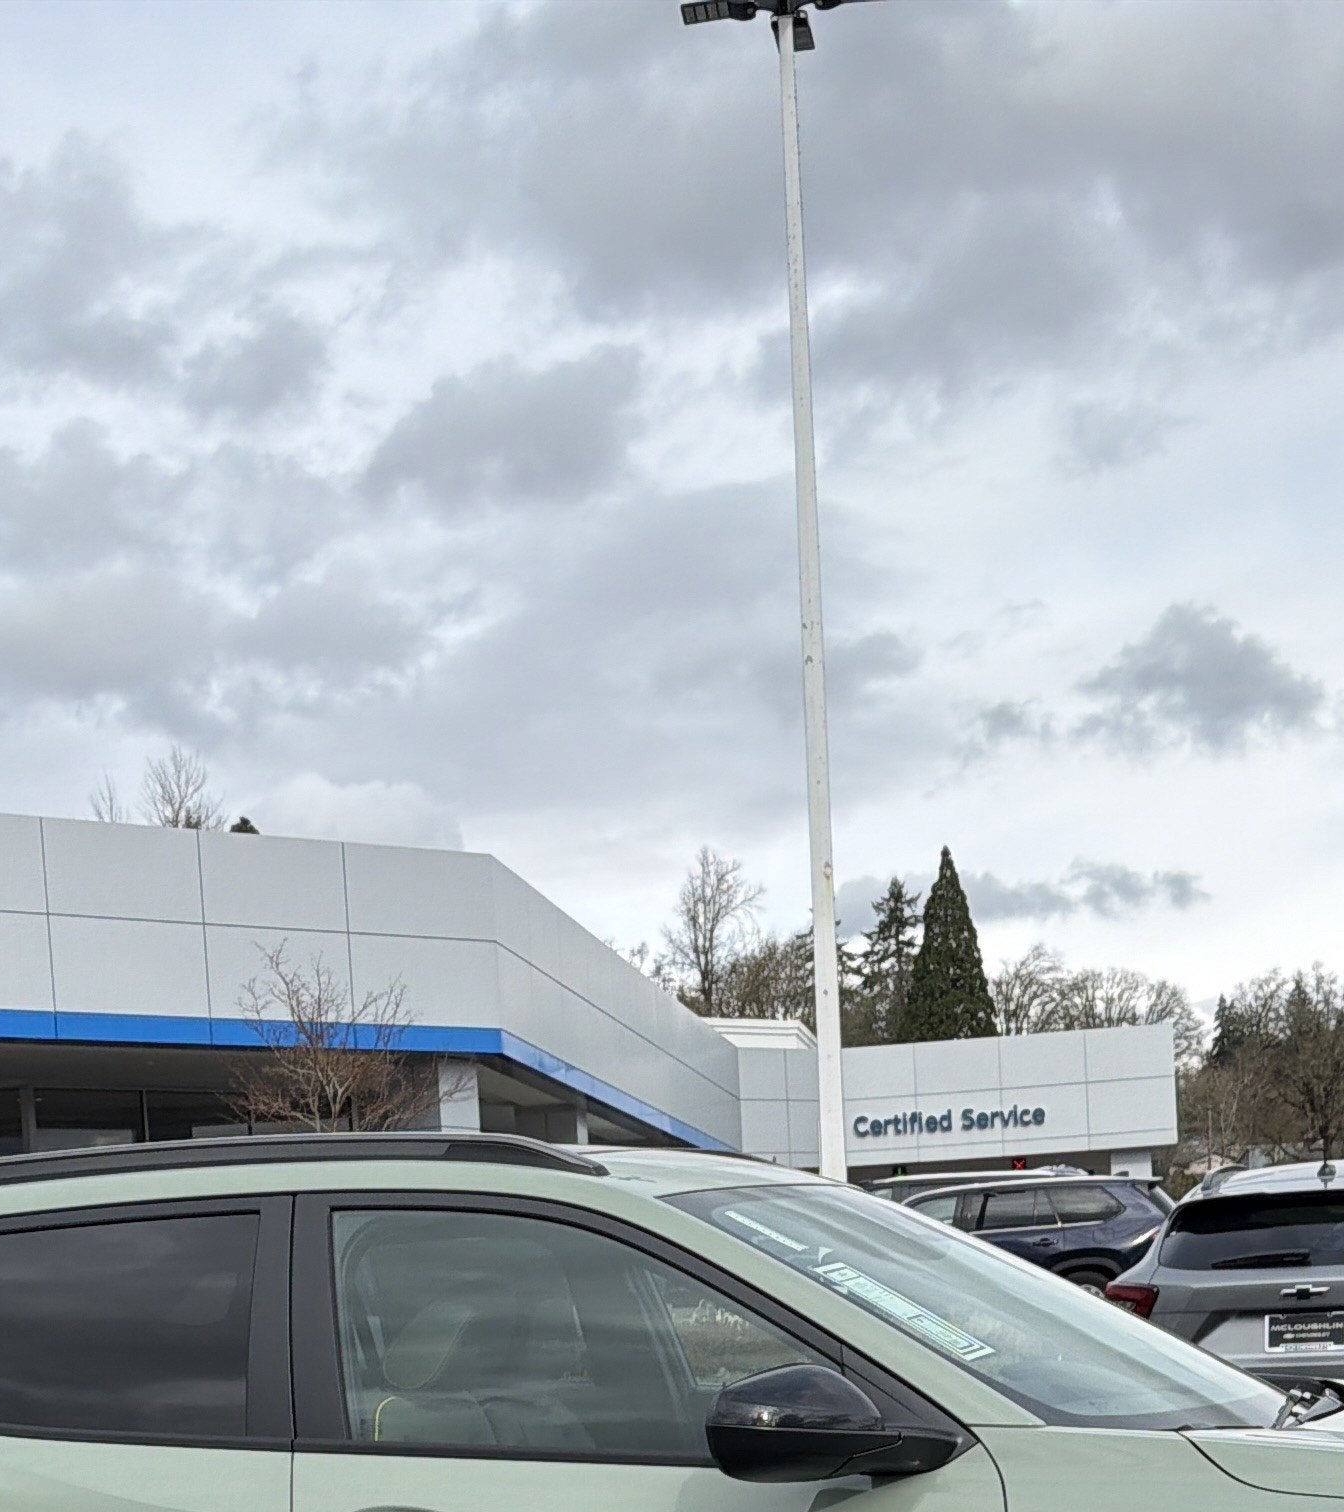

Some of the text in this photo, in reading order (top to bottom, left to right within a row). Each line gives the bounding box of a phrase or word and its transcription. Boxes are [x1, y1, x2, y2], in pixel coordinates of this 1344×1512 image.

[853, 1104, 1046, 1138] Certified Service
[1270, 1322, 1344, 1331] MCLOUGHLIN
